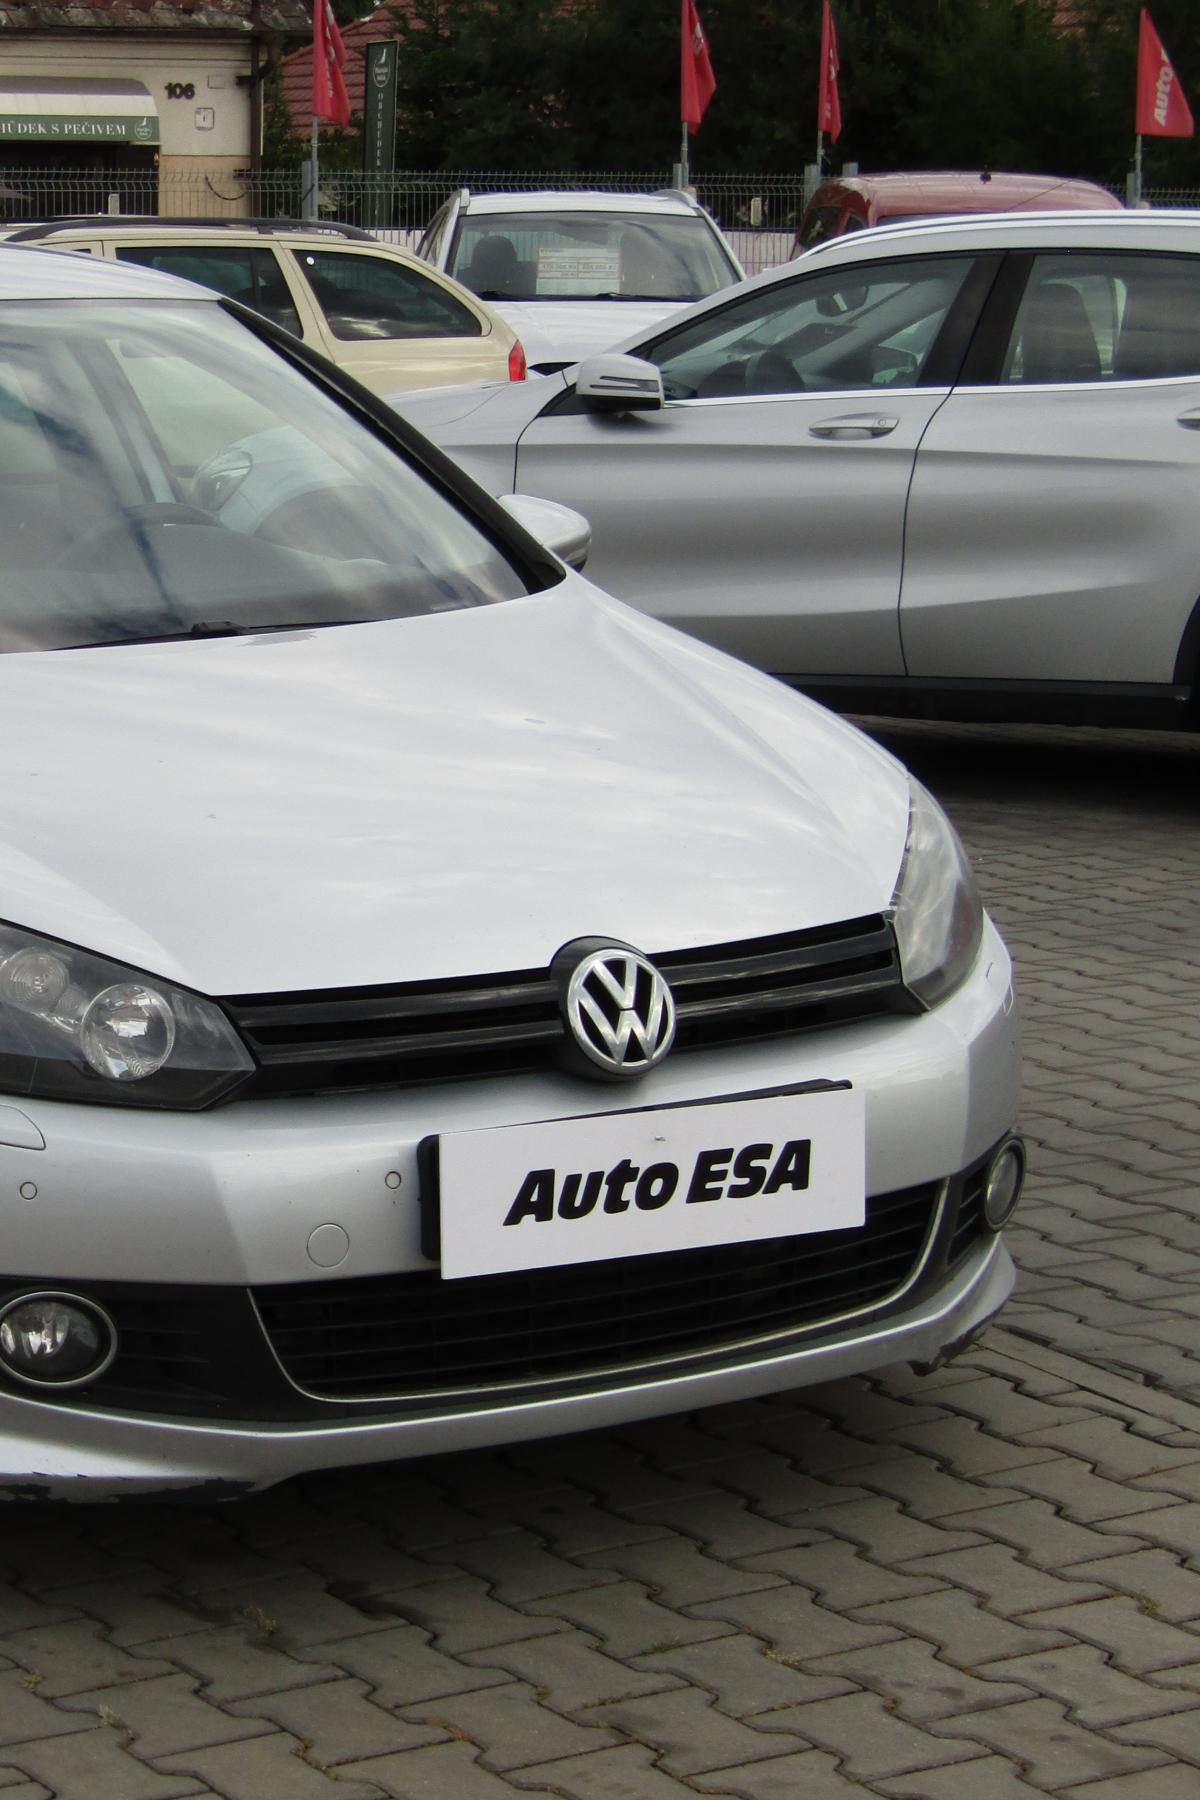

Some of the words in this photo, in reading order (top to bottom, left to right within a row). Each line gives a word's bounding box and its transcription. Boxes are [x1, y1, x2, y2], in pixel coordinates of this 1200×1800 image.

[164, 82, 195, 100] 106
[1154, 65, 1173, 127] Auto
[51, 123, 60, 135] S
[64, 121, 126, 135] PEČIVEM
[502, 1158, 680, 1226] Auto
[686, 1139, 812, 1204] ESA
